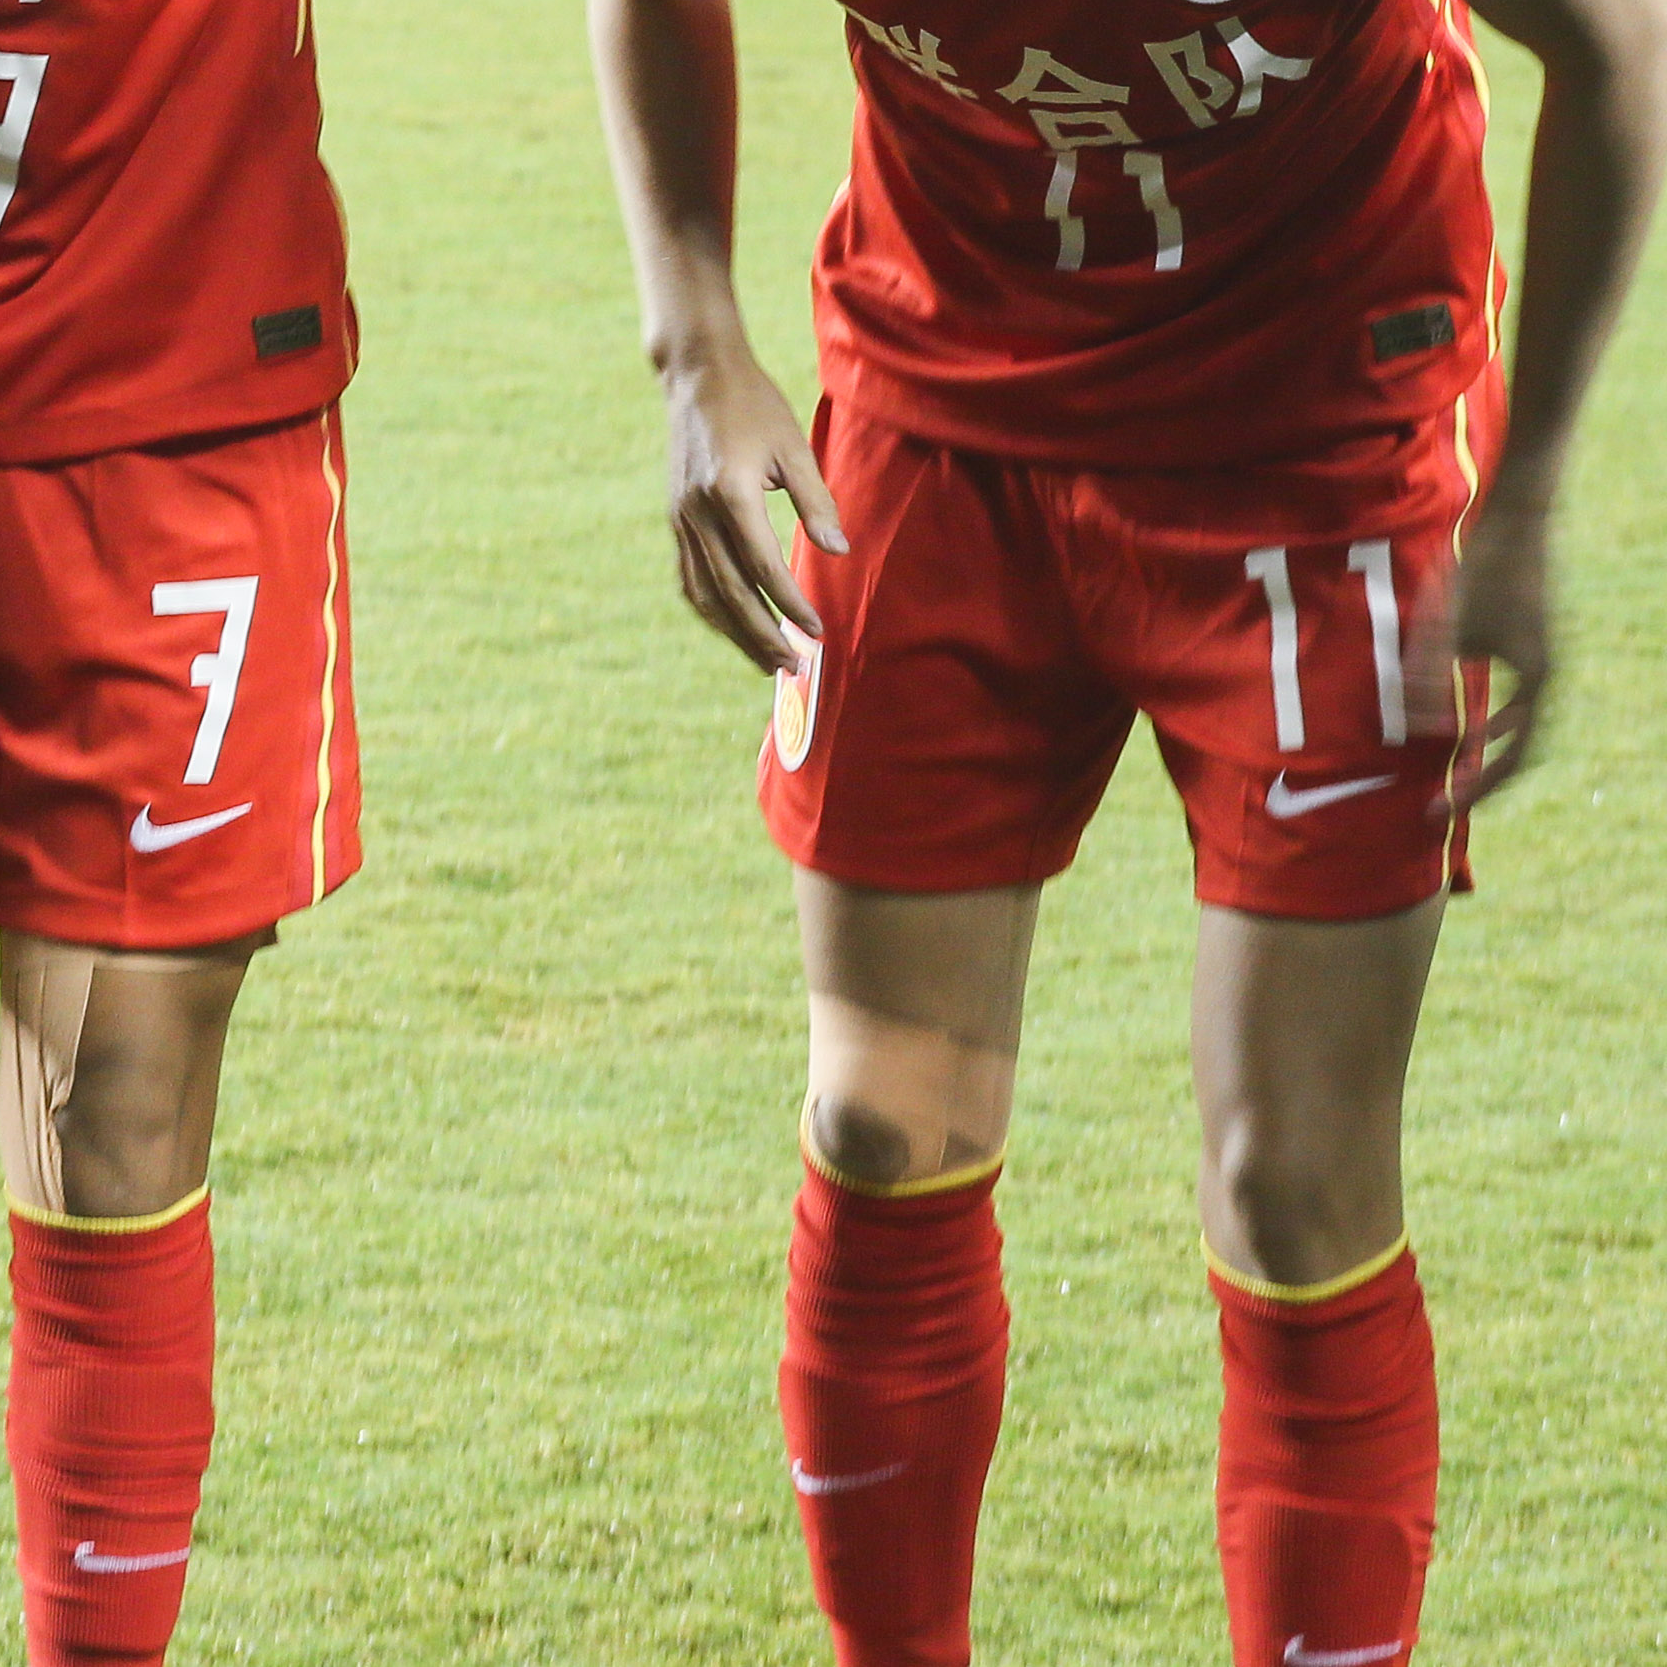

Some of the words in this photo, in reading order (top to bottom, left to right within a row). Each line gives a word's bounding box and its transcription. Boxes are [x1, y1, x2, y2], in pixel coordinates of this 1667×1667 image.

[1043, 150, 1183, 272] 11
[151, 575, 259, 785] 7
[1243, 540, 1408, 752] 11
